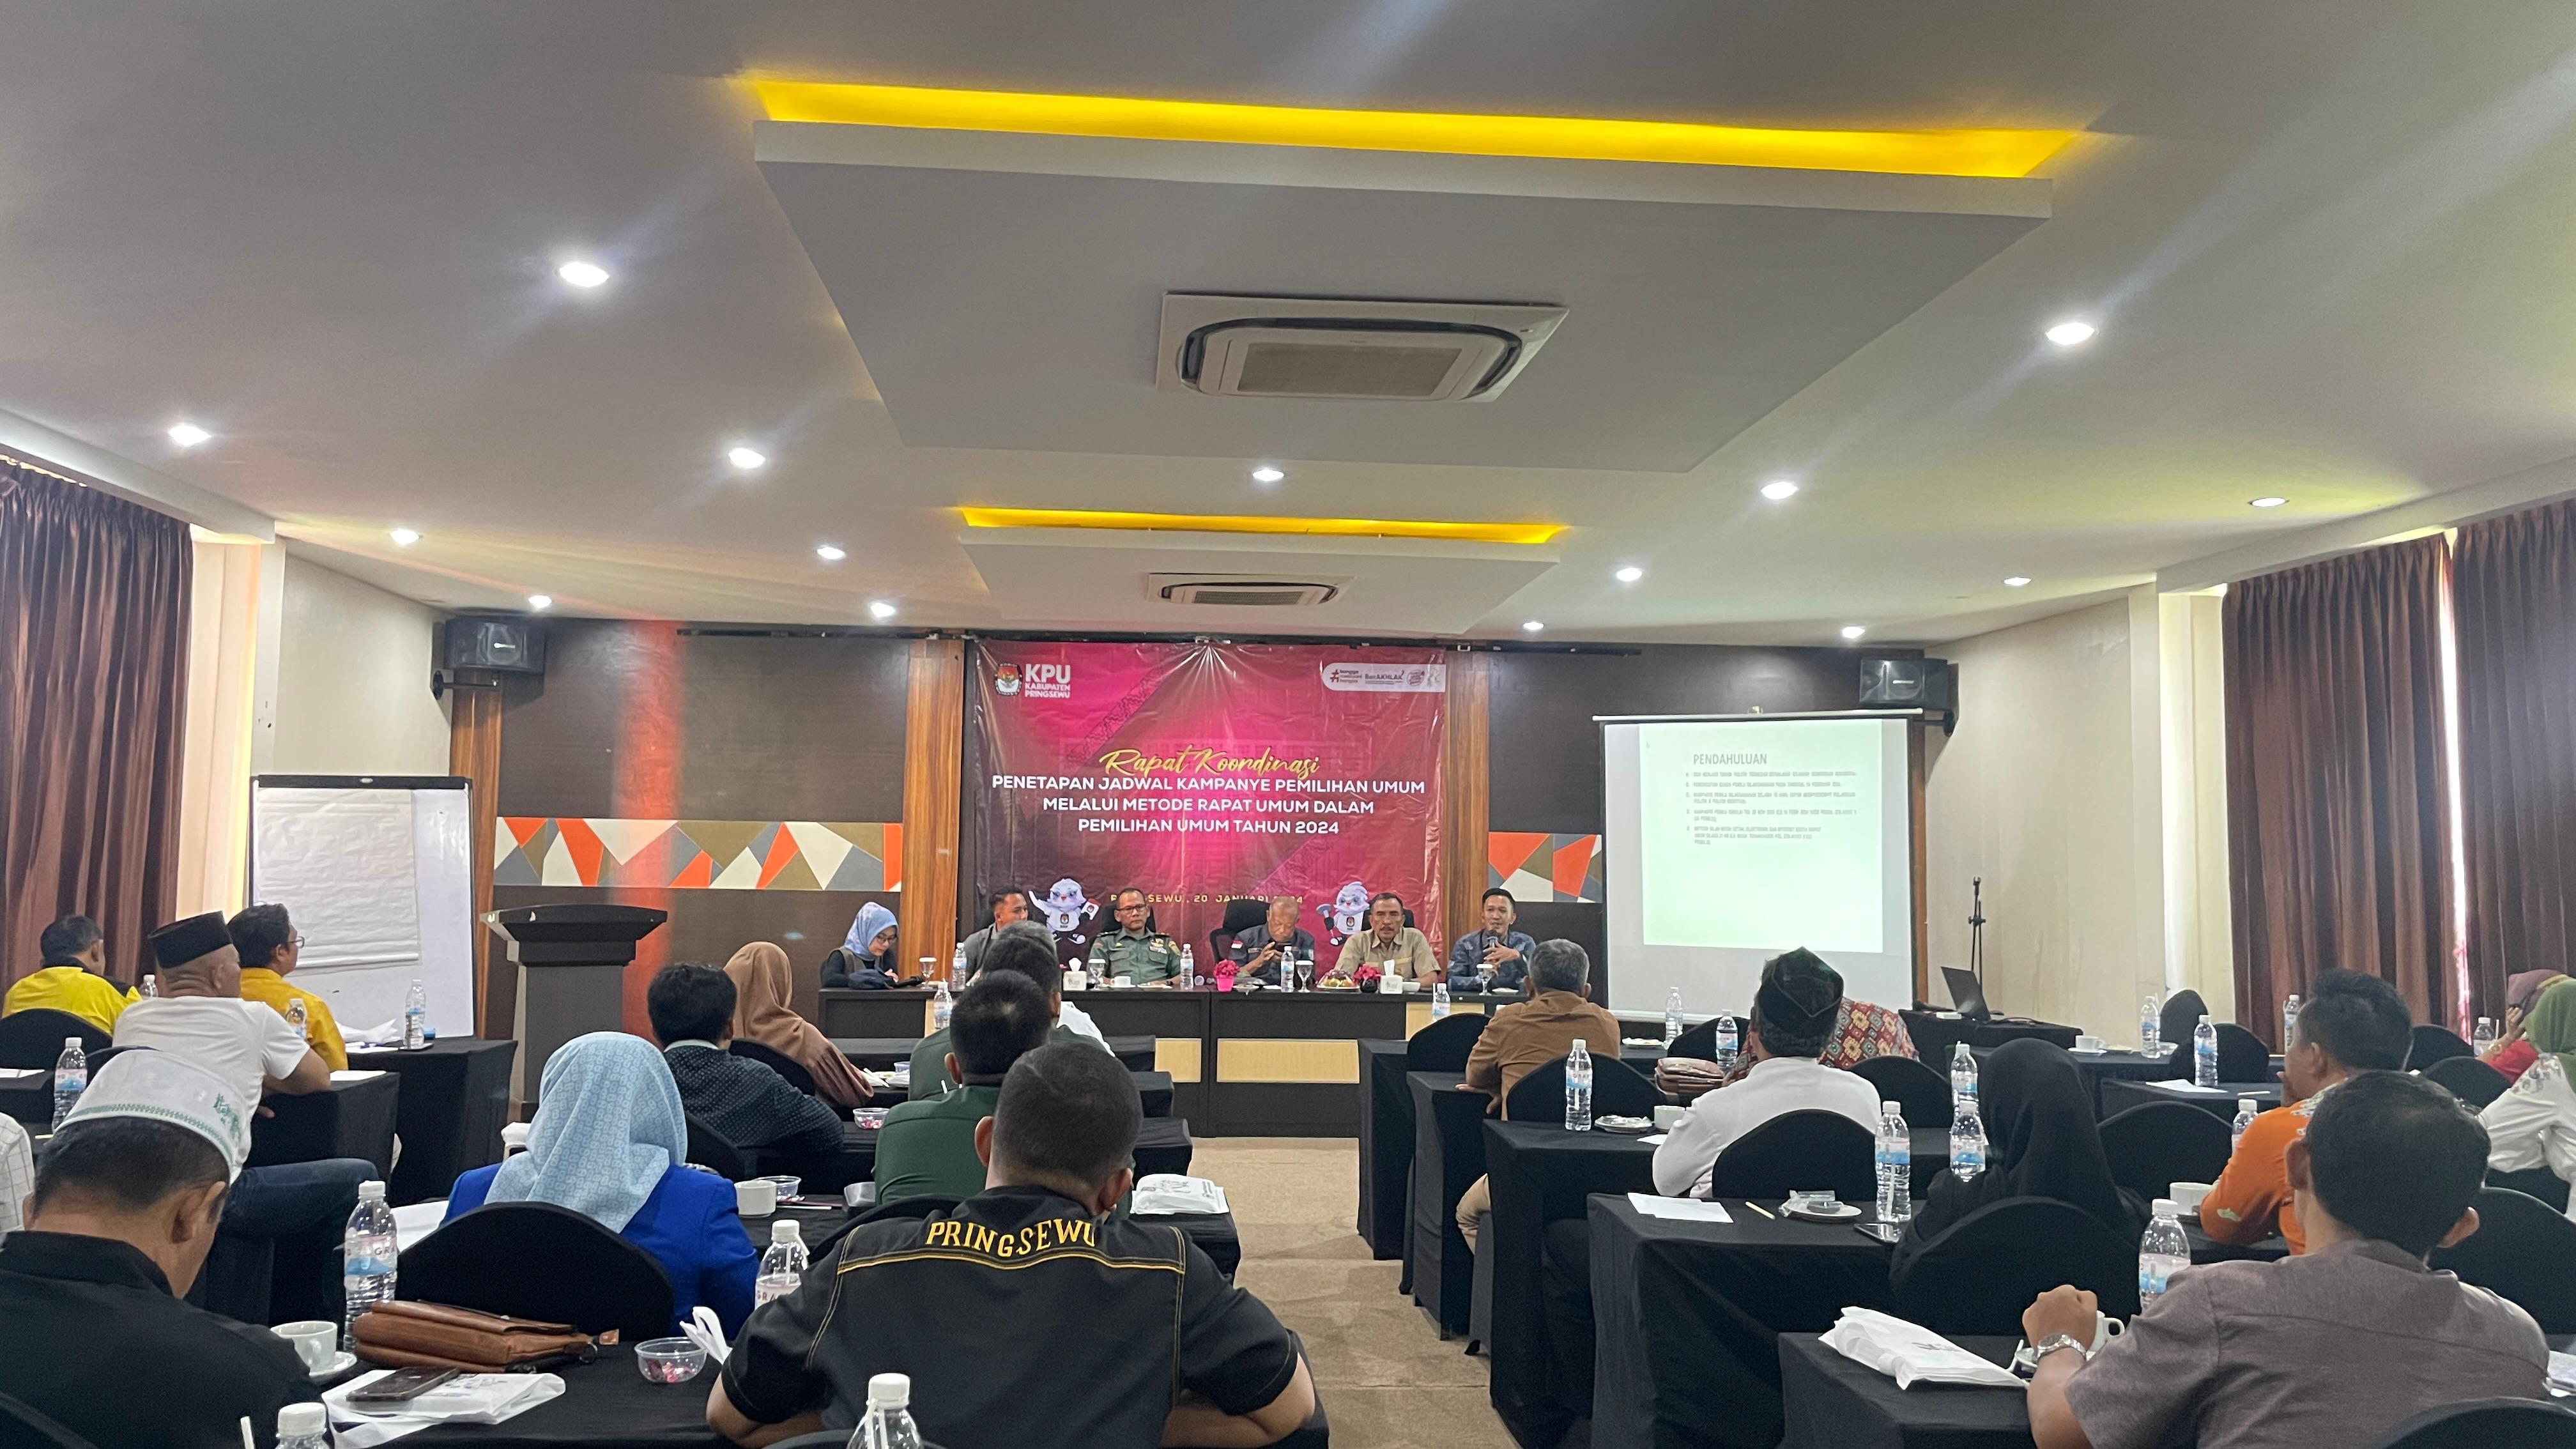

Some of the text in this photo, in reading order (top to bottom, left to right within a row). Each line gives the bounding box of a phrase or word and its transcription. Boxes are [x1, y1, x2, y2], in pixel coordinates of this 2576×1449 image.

[1025, 663, 1071, 684] KPU
[1025, 683, 1070, 691] KABUPATEN
[1025, 690, 1070, 698] PRINGSEWU
[1099, 744, 1320, 779] Rapat Koordinasi
[1693, 753, 1768, 765] PENDAHULUAN
[992, 775, 1425, 793] PENETAPAN JADWAL KAMPANYE PEMILIHAN UMUM
[1043, 797, 1374, 814] MELALUI METODE RAPAT UMUM DALAM
[1078, 818, 1339, 834] PEMILIHAN UMUM TAHUN 2024
[925, 1219, 1096, 1257] PRINGSEWU
